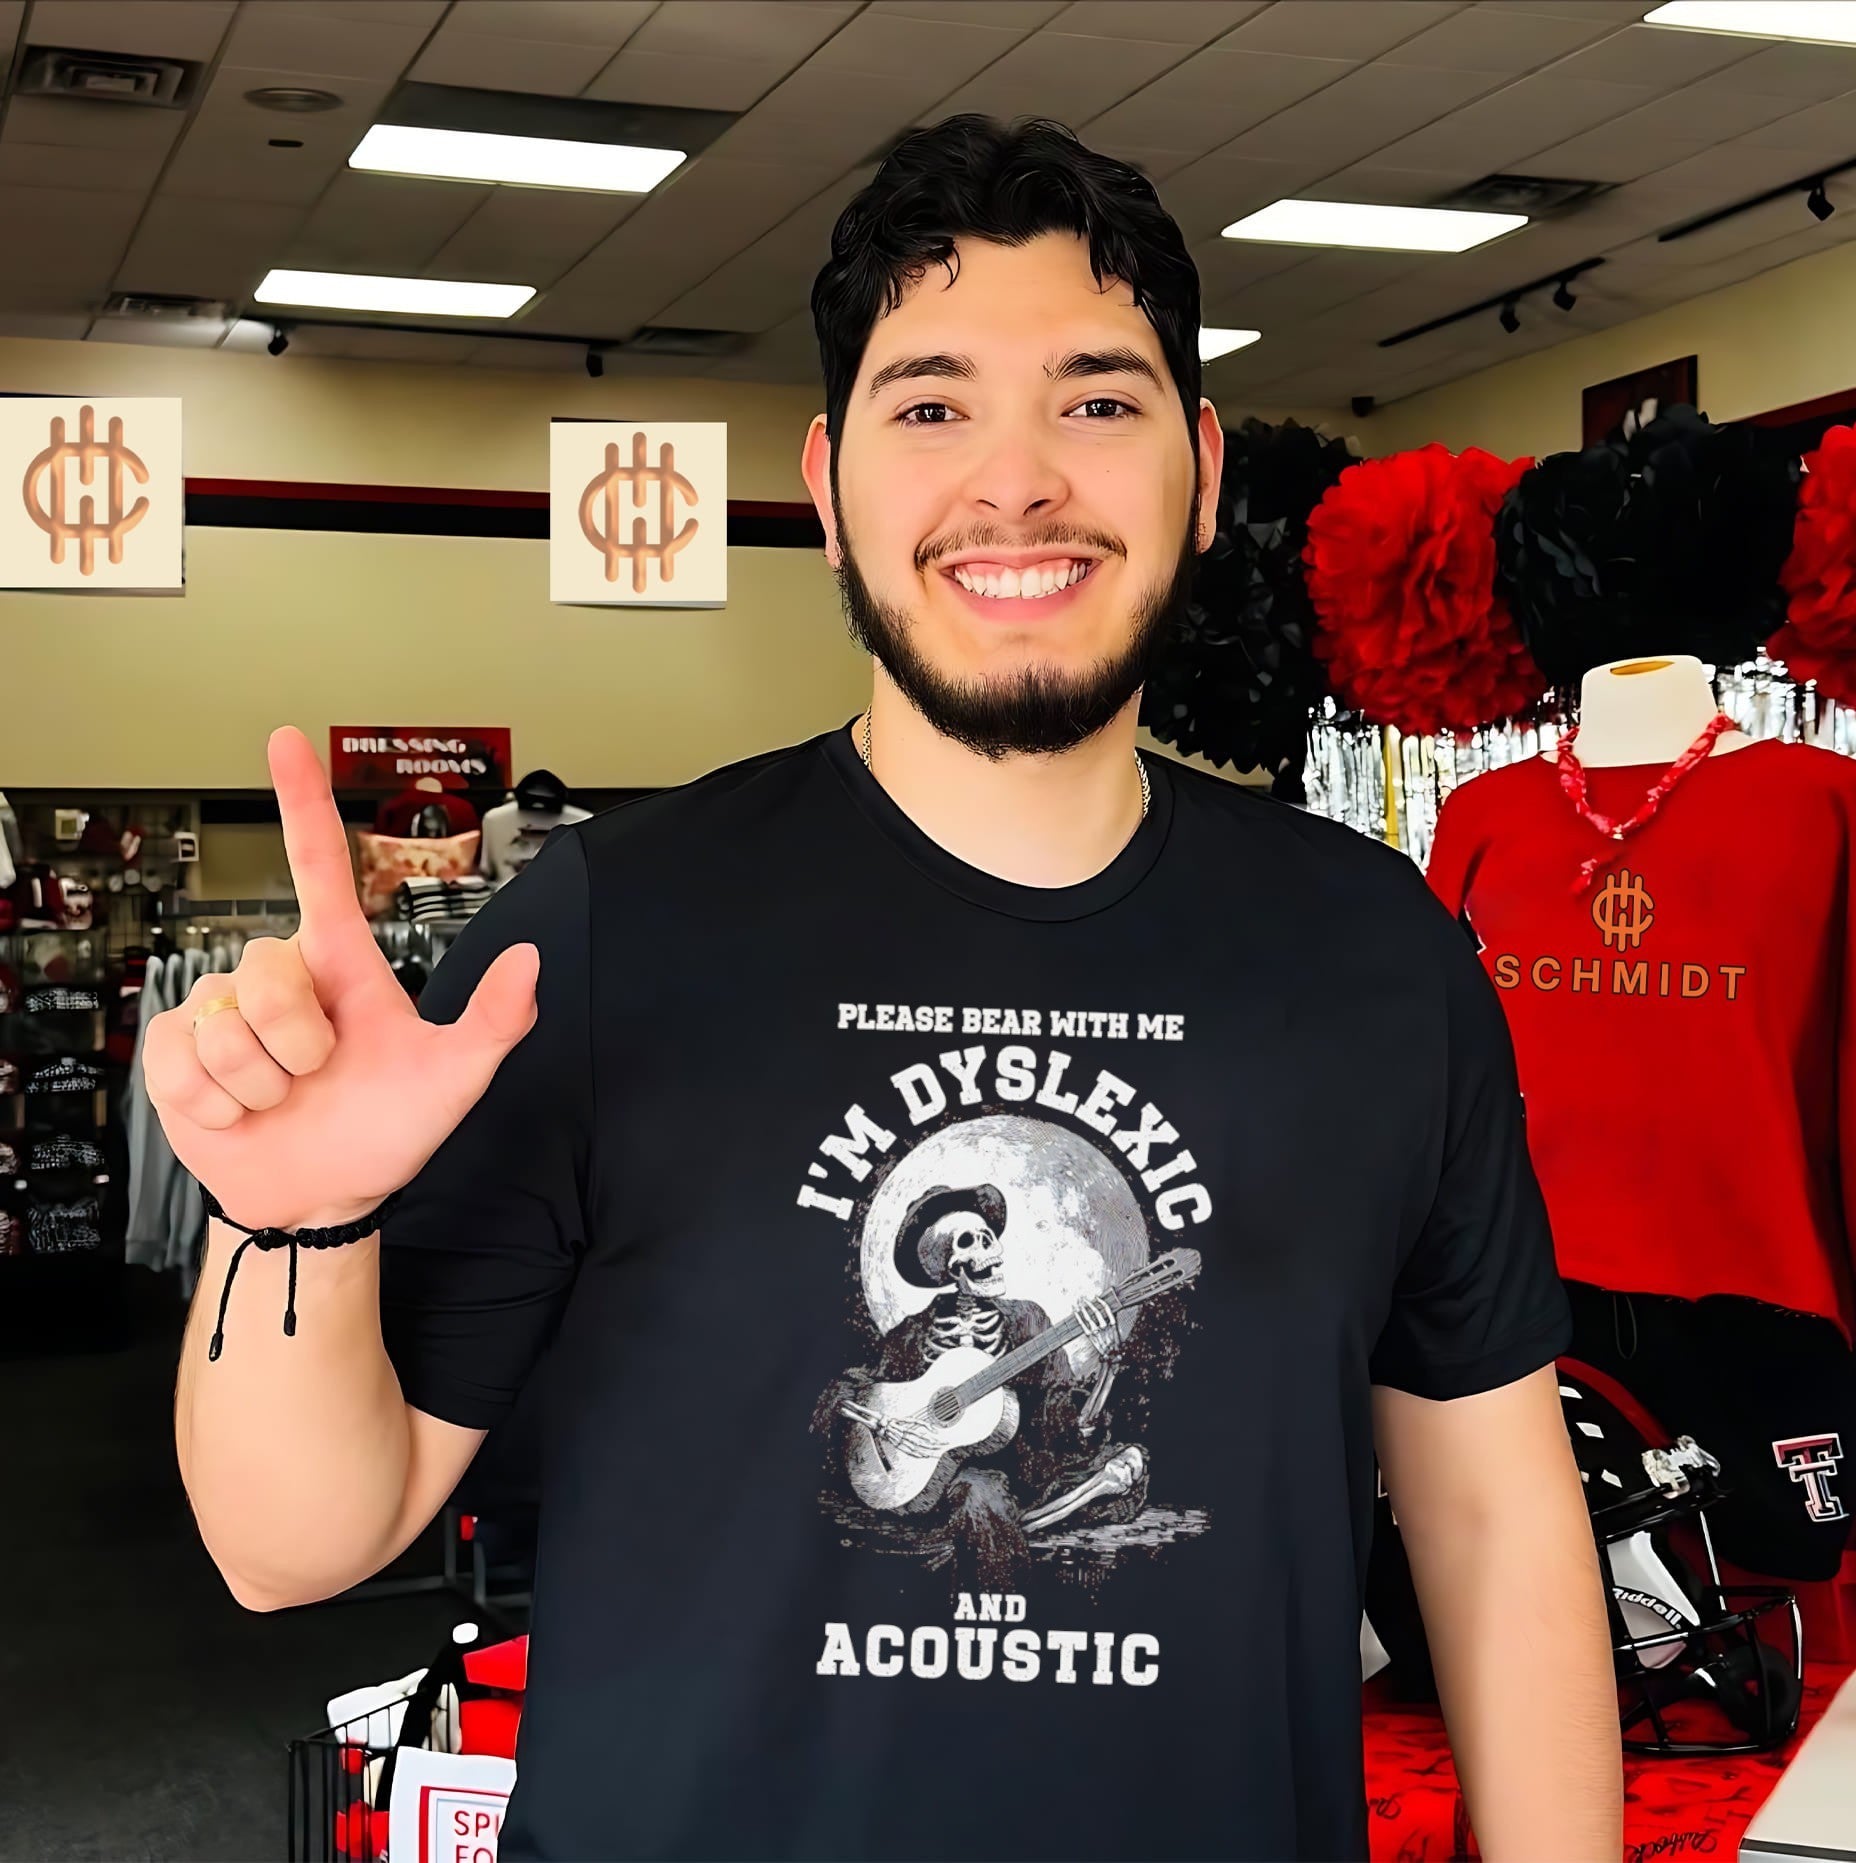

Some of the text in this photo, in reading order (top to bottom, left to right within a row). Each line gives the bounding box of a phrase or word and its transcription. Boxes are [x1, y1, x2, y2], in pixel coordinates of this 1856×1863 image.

[396, 758, 487, 775] ROOMS
[1494, 953, 1747, 1001] SCHMIDT
[837, 1003, 1185, 1041] PLEASE BEAR WITH ME
[797, 1044, 1213, 1231] I'M DYSLEXIC
[953, 1592, 1027, 1623] AND
[815, 1622, 1161, 1687] ACOUSTIC
